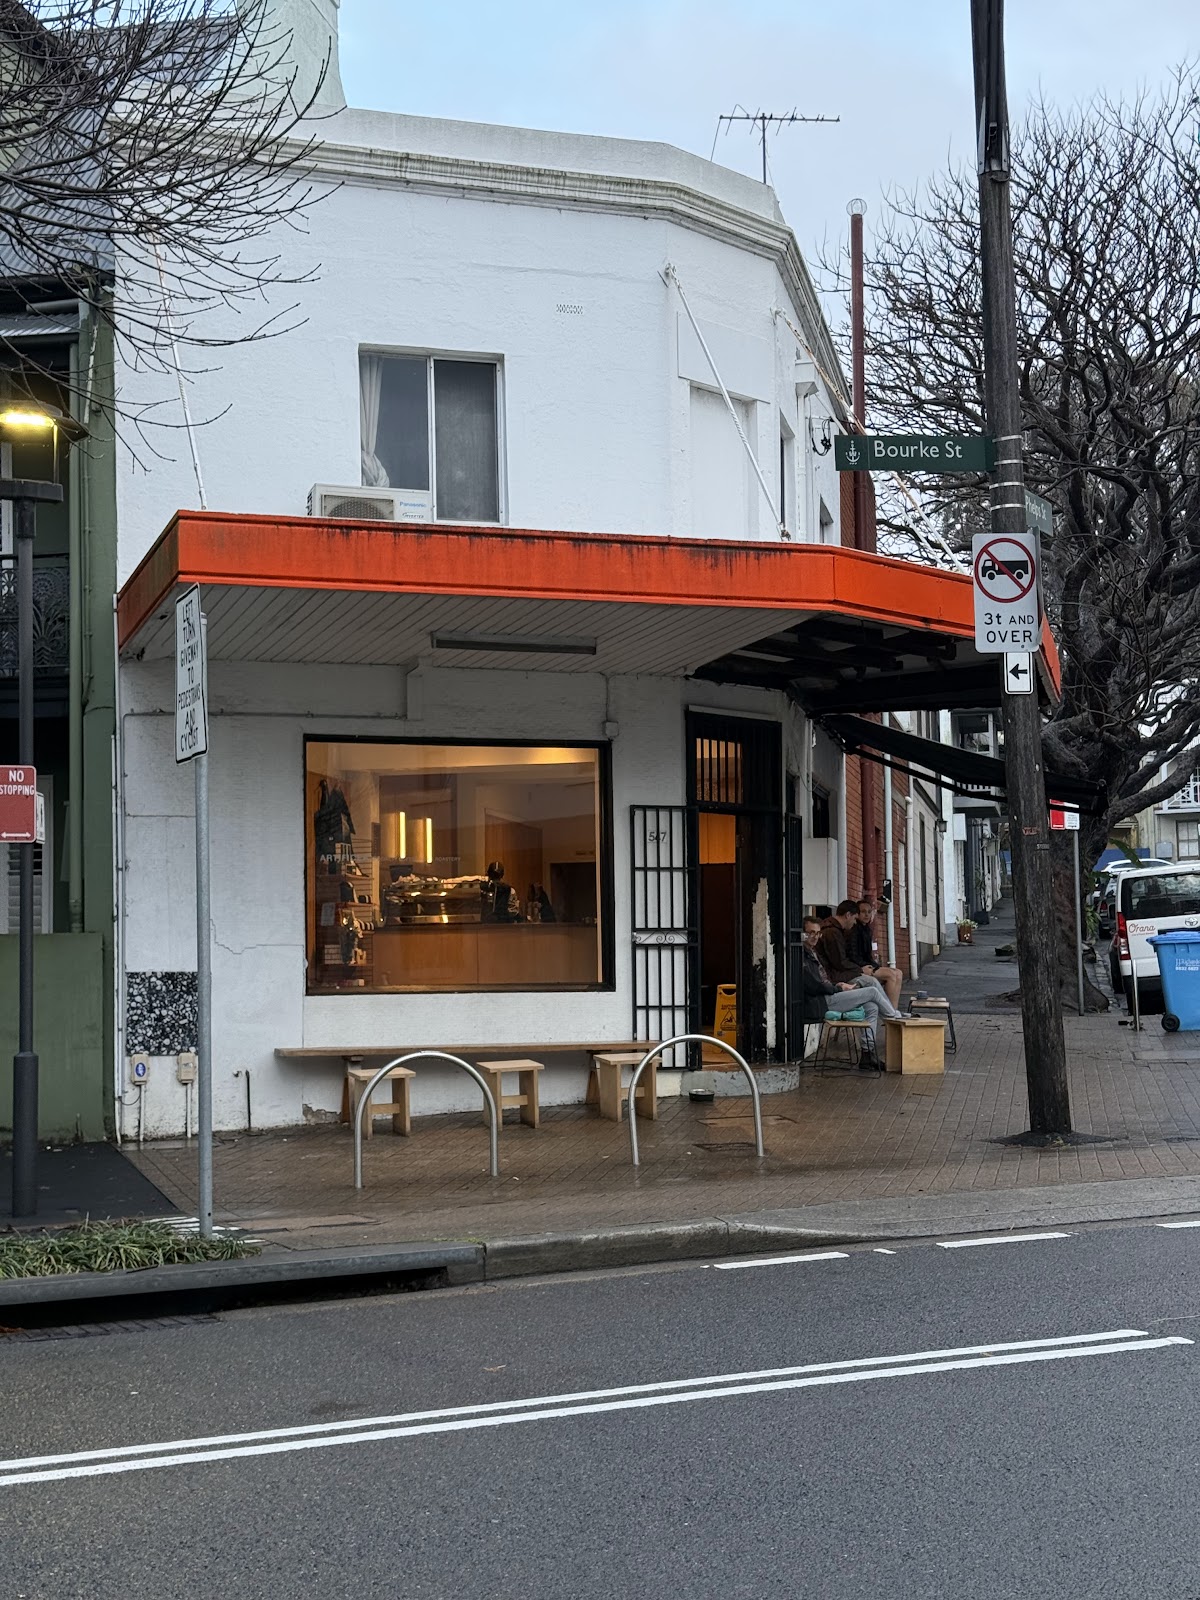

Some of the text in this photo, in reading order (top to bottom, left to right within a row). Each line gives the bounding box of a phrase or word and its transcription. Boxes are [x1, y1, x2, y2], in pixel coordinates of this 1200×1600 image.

[874, 440, 963, 458] Bourke St
[182, 600, 193, 623] LEFT
[984, 612, 1035, 626] 3t AND
[182, 621, 195, 644] TURN
[986, 630, 1033, 644] OVER
[187, 666, 194, 685] TO
[185, 708, 196, 732] AND
[9, 770, 24, 782] NO
[0, 785, 35, 795] STOPPING
[319, 853, 369, 863] ARTIFIC
